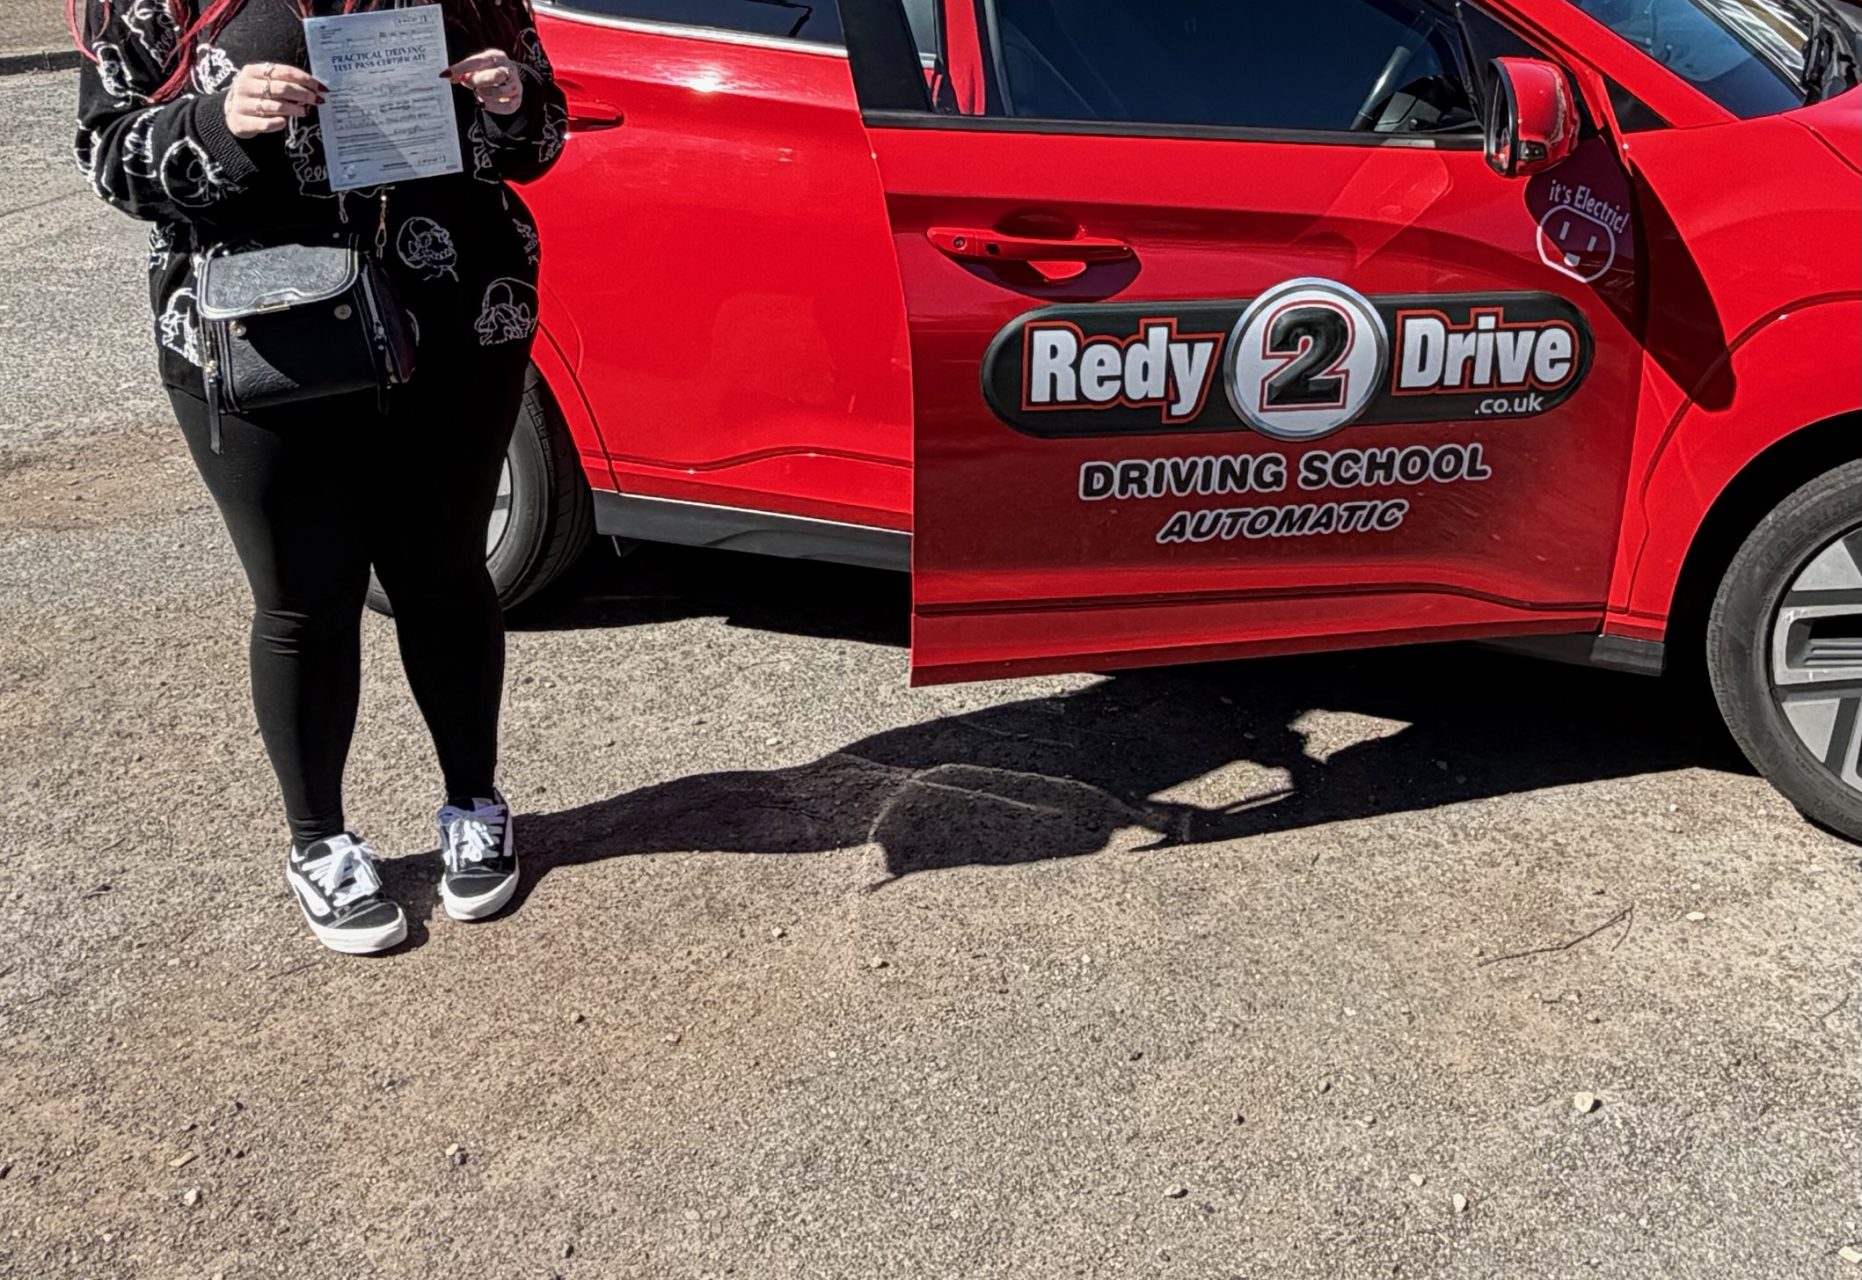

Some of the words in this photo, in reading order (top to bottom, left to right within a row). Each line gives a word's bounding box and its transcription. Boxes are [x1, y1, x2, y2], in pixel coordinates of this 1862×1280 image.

[331, 50, 383, 64] PRACTICAL
[384, 44, 426, 57] DRIVING
[333, 63, 353, 72] TEST
[355, 60, 375, 70] PASS
[1549, 179, 1573, 204] it's
[1573, 185, 1631, 234] Electric!
[1028, 323, 1218, 418] Redy
[1263, 304, 1353, 408] 2
[1398, 314, 1574, 390] Drive
[1474, 393, 1545, 416] .co.uk
[1078, 452, 1287, 501] DRIVING
[1297, 443, 1492, 490] SCHOOL
[1156, 499, 1409, 544] AUTOMATIC
